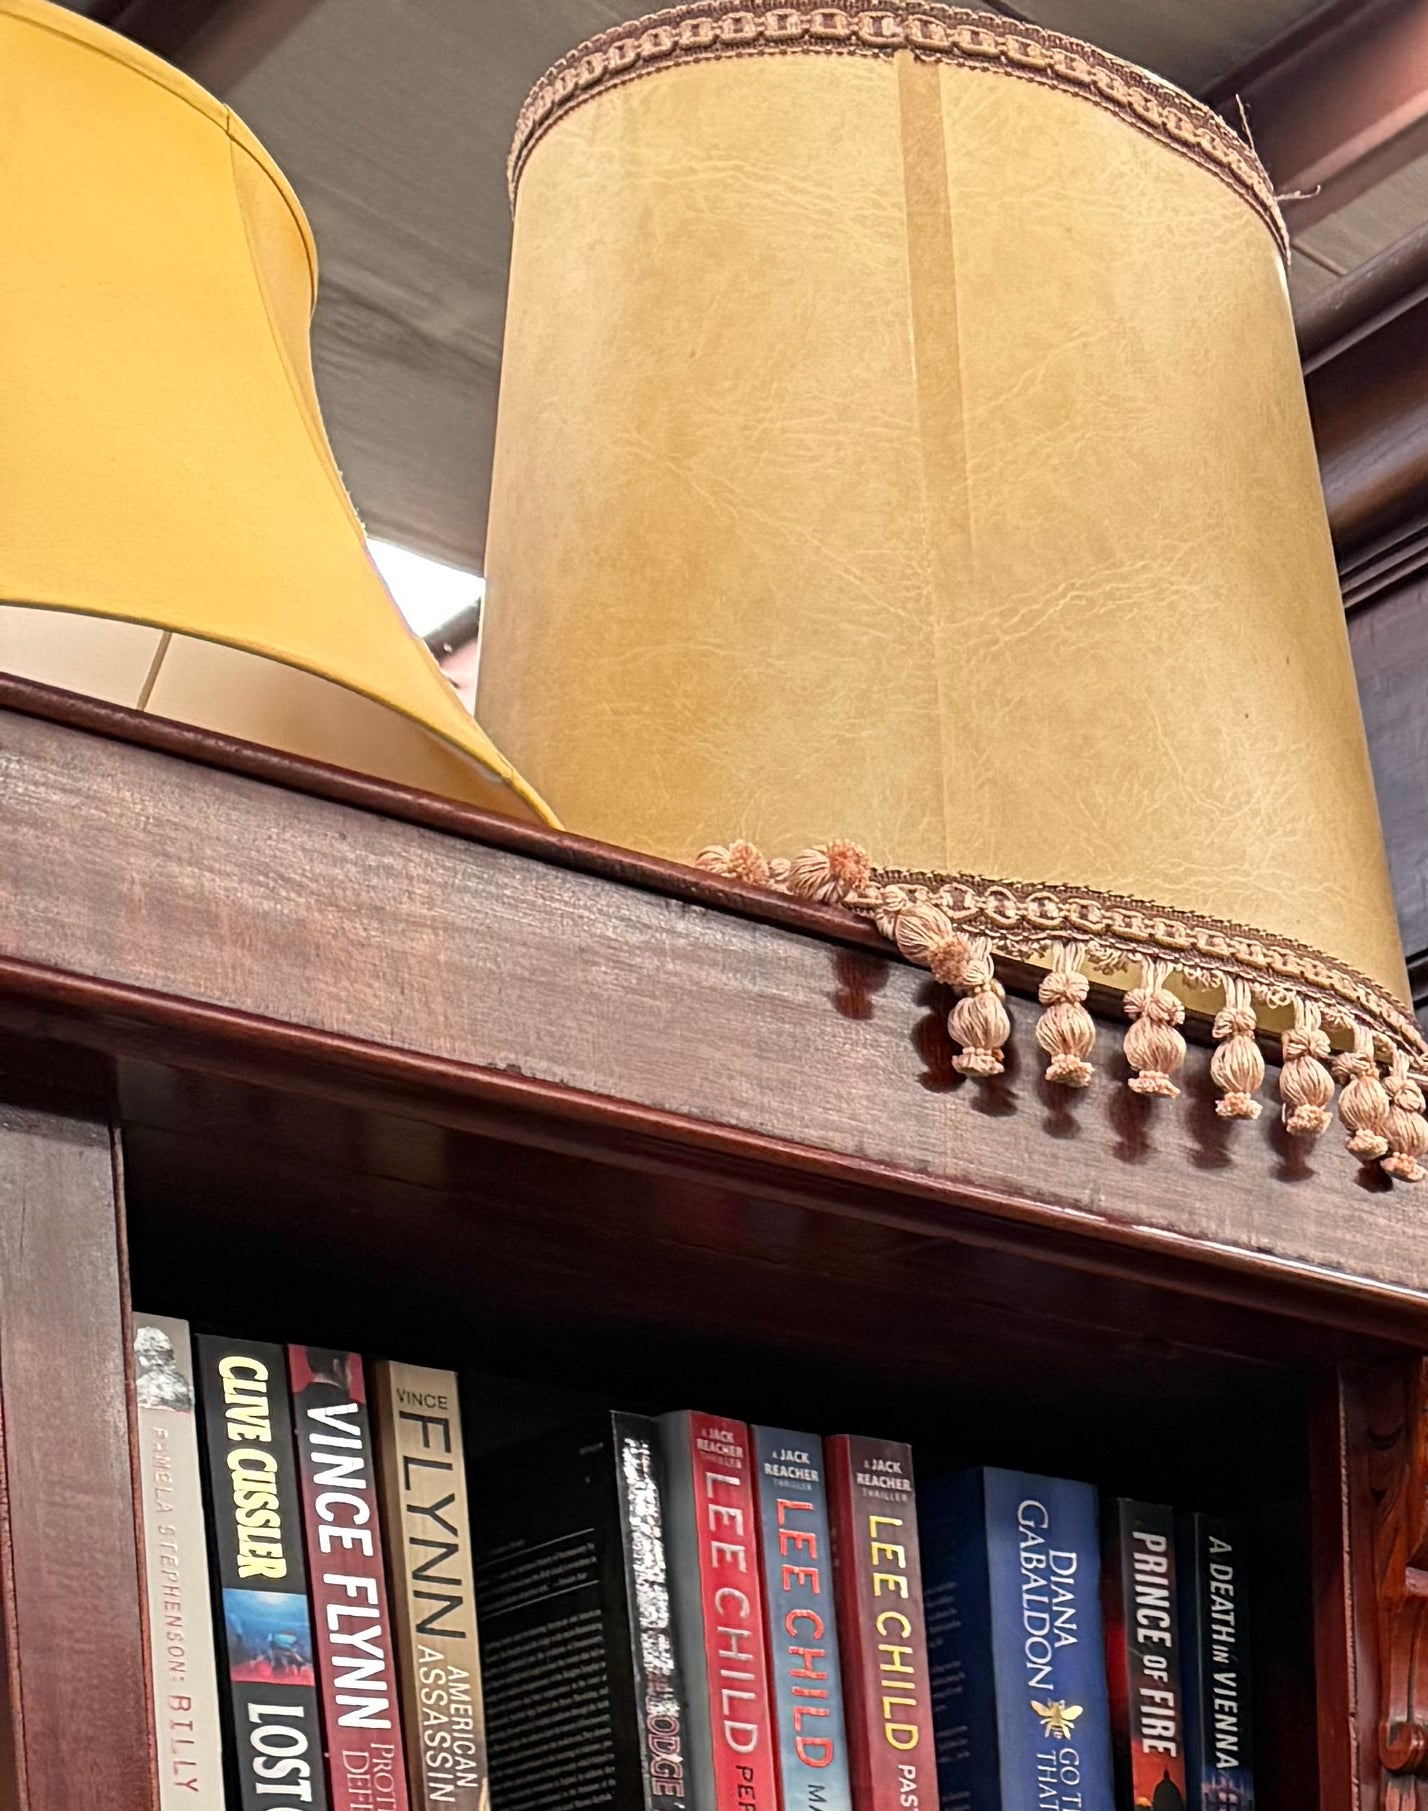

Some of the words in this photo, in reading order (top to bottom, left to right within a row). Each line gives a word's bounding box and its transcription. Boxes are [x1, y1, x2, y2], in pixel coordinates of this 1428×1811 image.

[218, 1355, 272, 1442] CLIVE
[396, 1387, 448, 1410] VINCE
[226, 1448, 288, 1579] CUSSLER
[307, 1402, 374, 1557] VINCE
[705, 1472, 748, 1573] LEE
[764, 1463, 820, 1482] REACHER
[856, 1472, 912, 1492] REACHER
[398, 1410, 467, 1639] FLYNN
[776, 1498, 821, 1594] LEE
[869, 1515, 909, 1599] LEE
[1017, 1499, 1054, 1690] GABALDON
[1049, 1548, 1078, 1648] DIANA
[1132, 1530, 1172, 1648] PRINCE
[323, 1573, 392, 1729] FLYNN
[714, 1587, 759, 1754] CHILD
[785, 1609, 834, 1769] CHILD
[876, 1611, 919, 1750] CHILD
[1143, 1655, 1168, 1684] OF
[247, 1702, 313, 1802] LOST
[417, 1644, 456, 1803] ASSASSIN
[447, 1666, 479, 1788] AMERICAN
[1059, 1748, 1080, 1785] GO
[1140, 1688, 1178, 1758] FIRE
